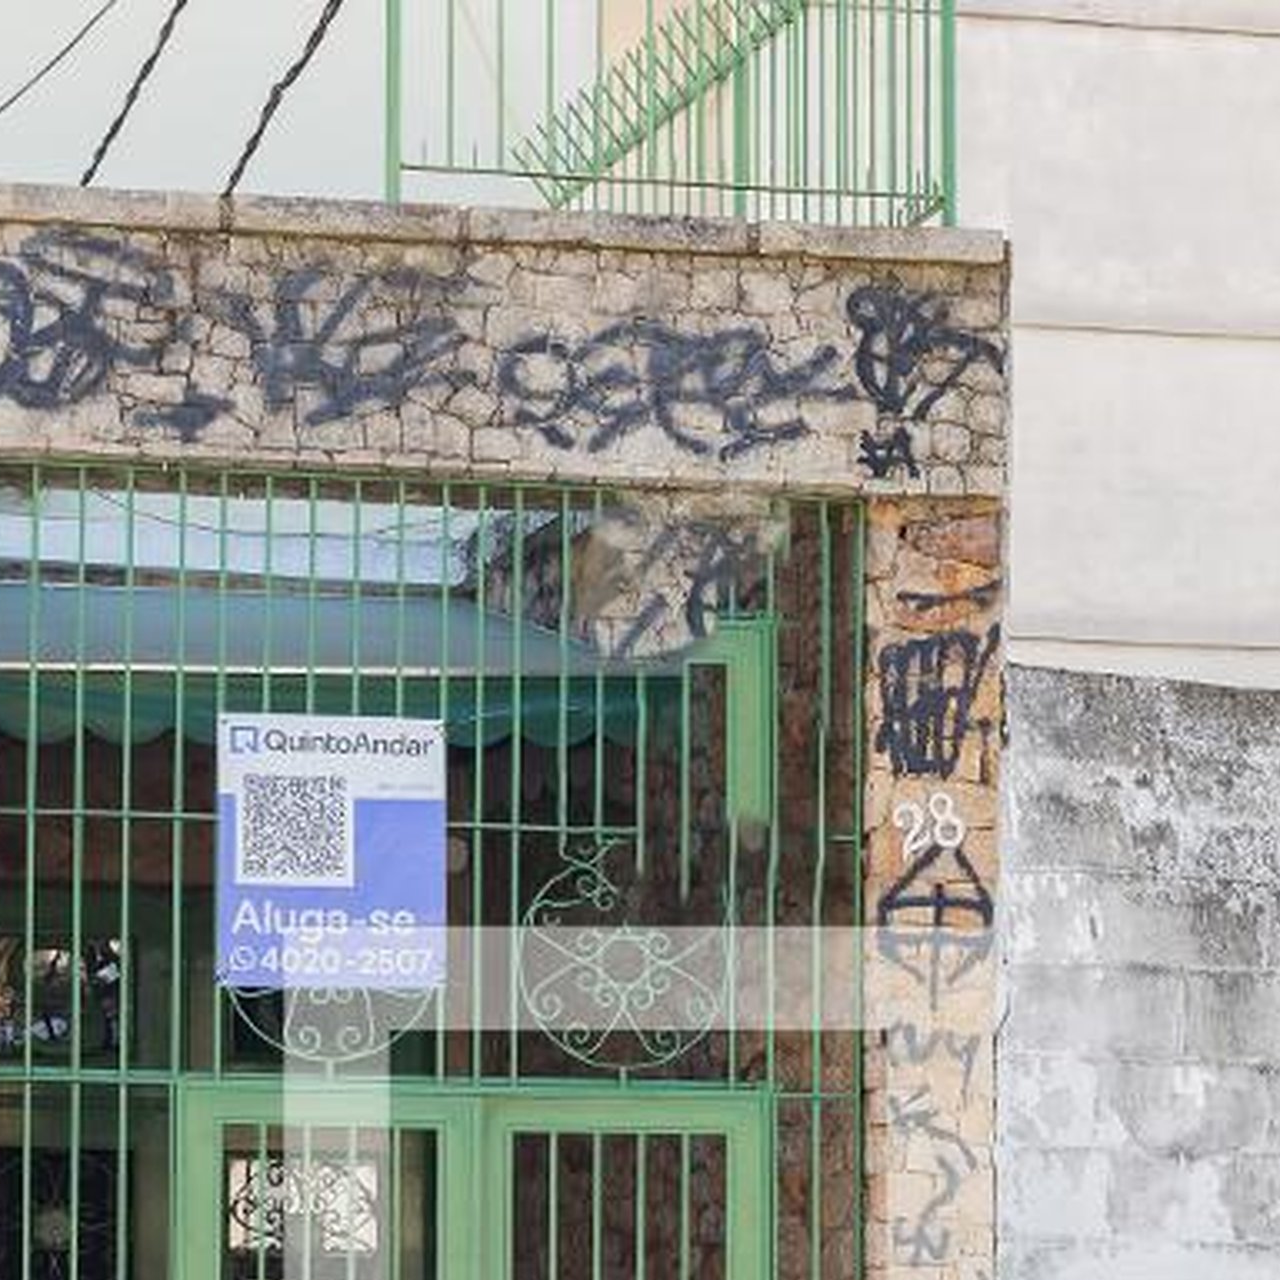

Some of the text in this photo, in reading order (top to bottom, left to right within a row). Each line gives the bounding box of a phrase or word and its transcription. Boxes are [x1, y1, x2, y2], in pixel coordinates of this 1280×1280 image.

[263, 728, 435, 757] QuintoAndar
[893, 793, 965, 860] 28
[231, 900, 417, 943] Aluga-se
[261, 946, 433, 976] 4020-2507
